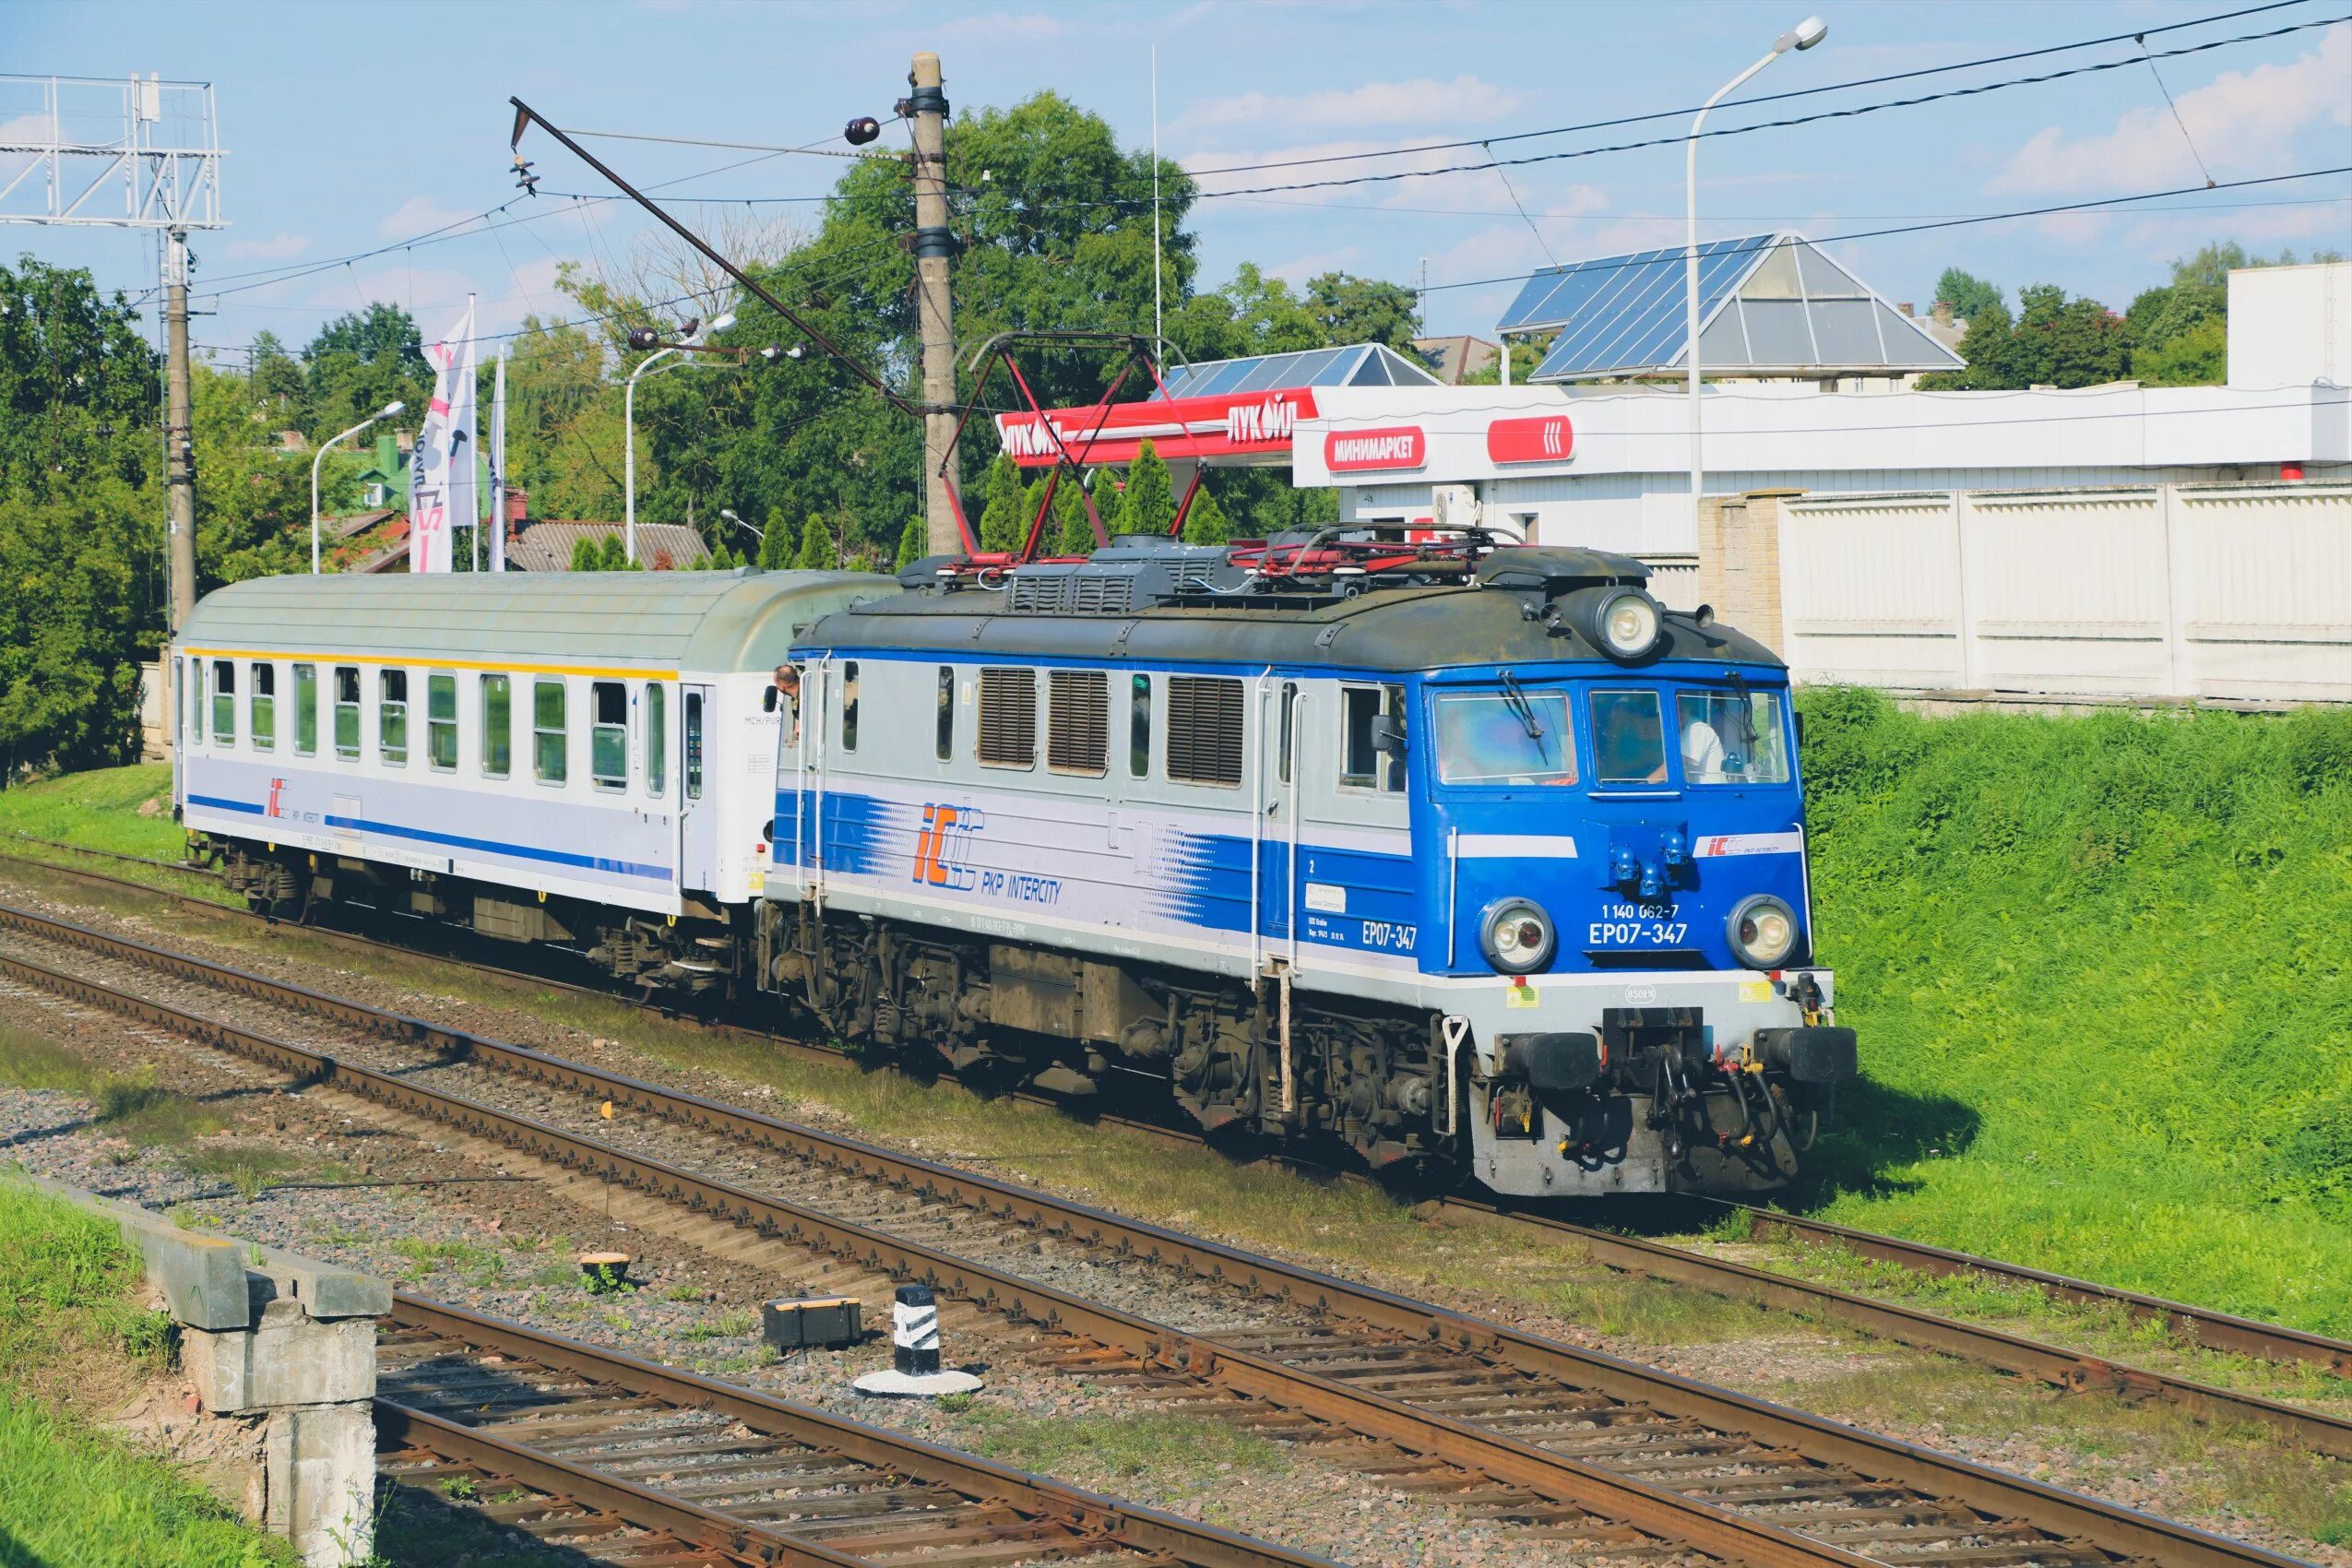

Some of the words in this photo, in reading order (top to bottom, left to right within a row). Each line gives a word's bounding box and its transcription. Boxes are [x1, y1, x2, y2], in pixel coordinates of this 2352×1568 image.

[1227, 393, 1298, 442] ЛУКОЙЛ
[1334, 435, 1414, 463] МИНИМАРКЕТ
[1309, 860, 1314, 873] 2
[981, 871, 1004, 897] PKP
[1007, 874, 1063, 905] INTERCITY
[1602, 904, 1608, 919] 1
[1612, 904, 1634, 919] 140
[1638, 904, 1679, 919] 062-7
[1362, 921, 1418, 950] EP07-347
[1589, 922, 1687, 944] EP07-347
